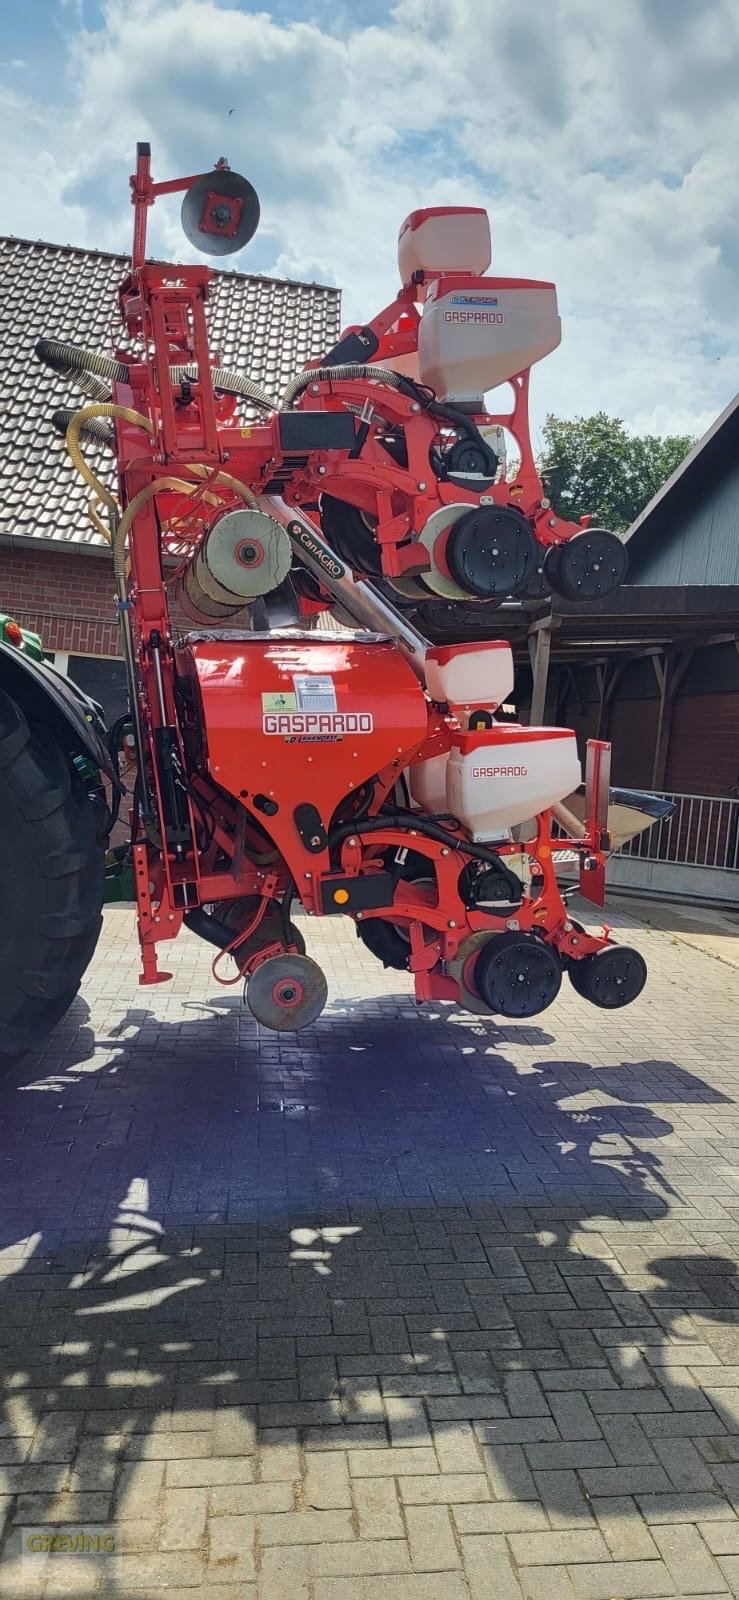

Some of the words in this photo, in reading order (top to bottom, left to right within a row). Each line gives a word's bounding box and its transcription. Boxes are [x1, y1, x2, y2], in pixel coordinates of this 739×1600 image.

[444, 311, 504, 324] GASPARDO
[300, 533, 341, 575] CanAGRO
[264, 714, 372, 733] GASPARDO
